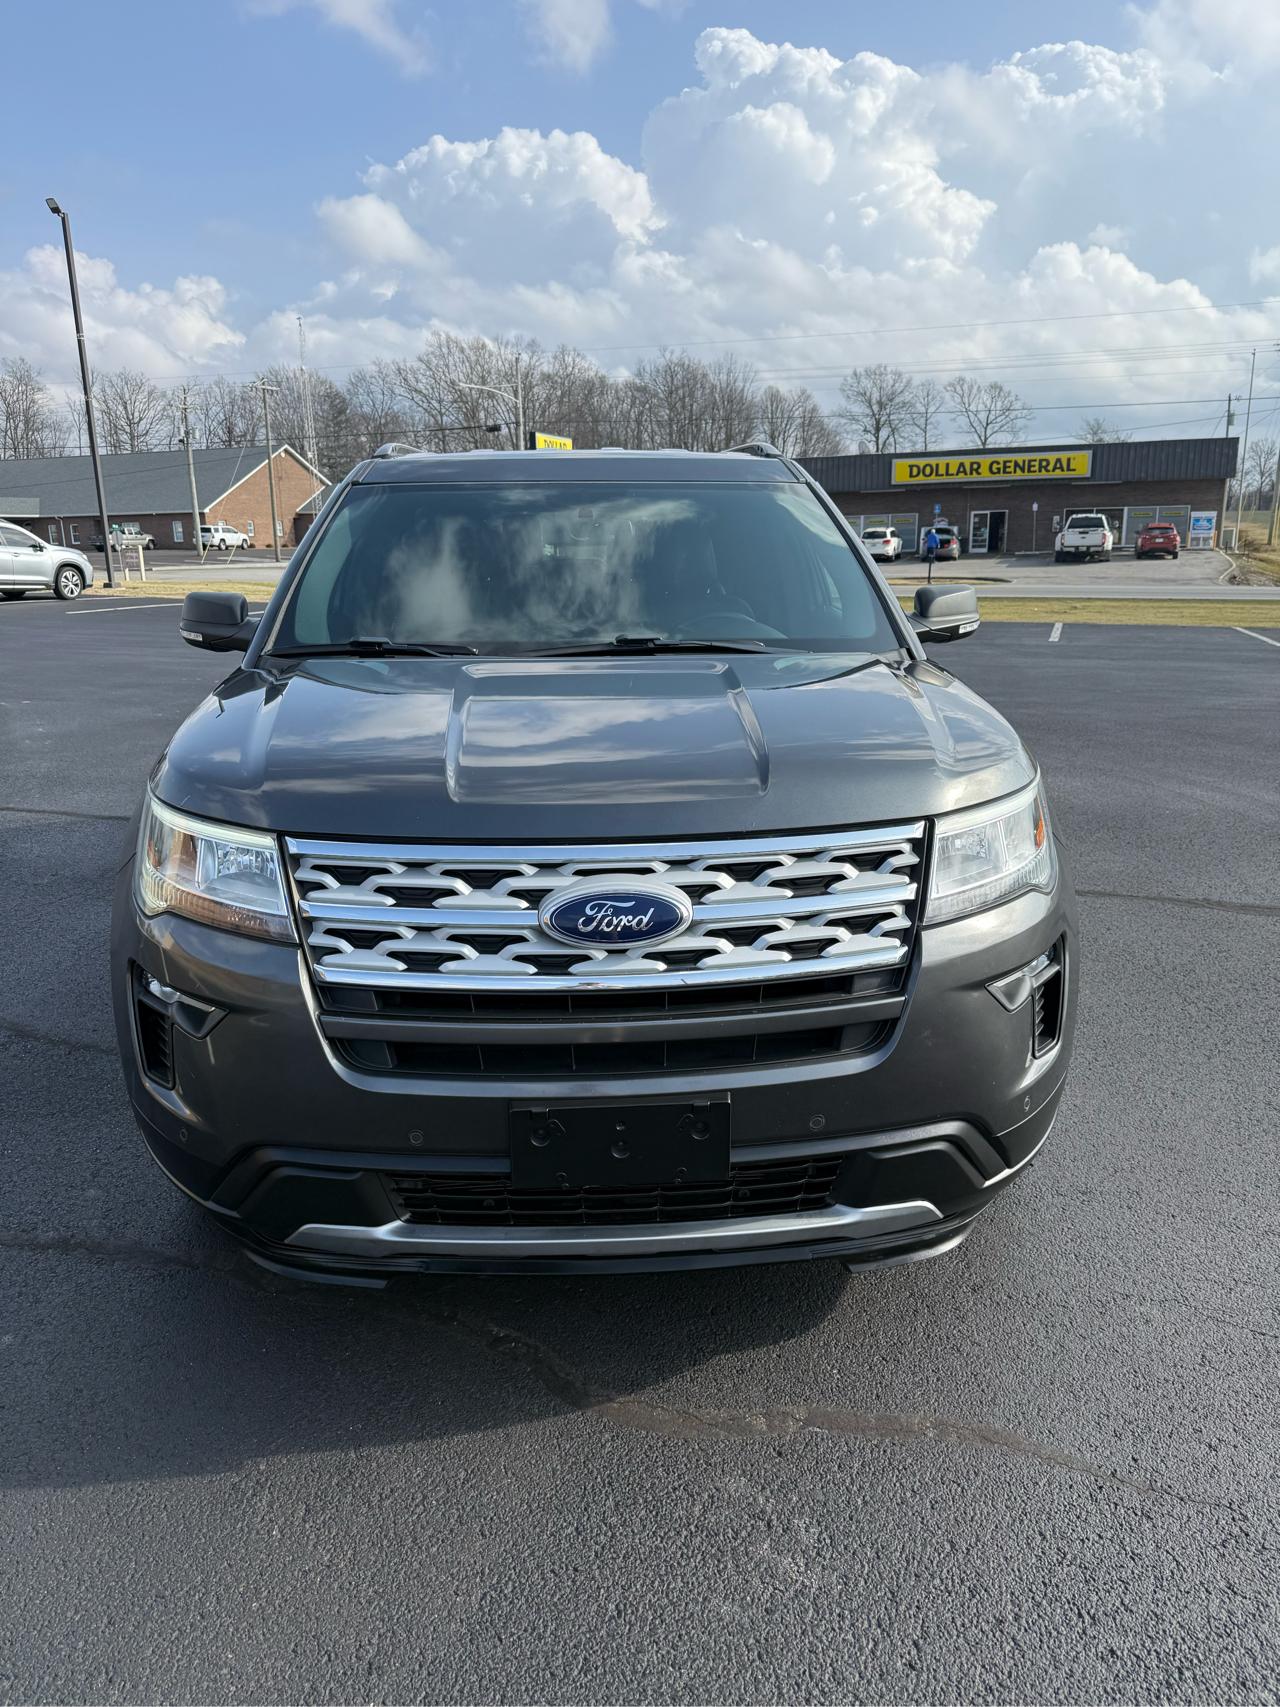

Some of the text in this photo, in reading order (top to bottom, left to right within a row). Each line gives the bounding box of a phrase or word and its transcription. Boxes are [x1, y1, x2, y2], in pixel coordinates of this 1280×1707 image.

[908, 457, 1076, 478] DOLLAR GENERAL
[577, 900, 654, 933] Ford
